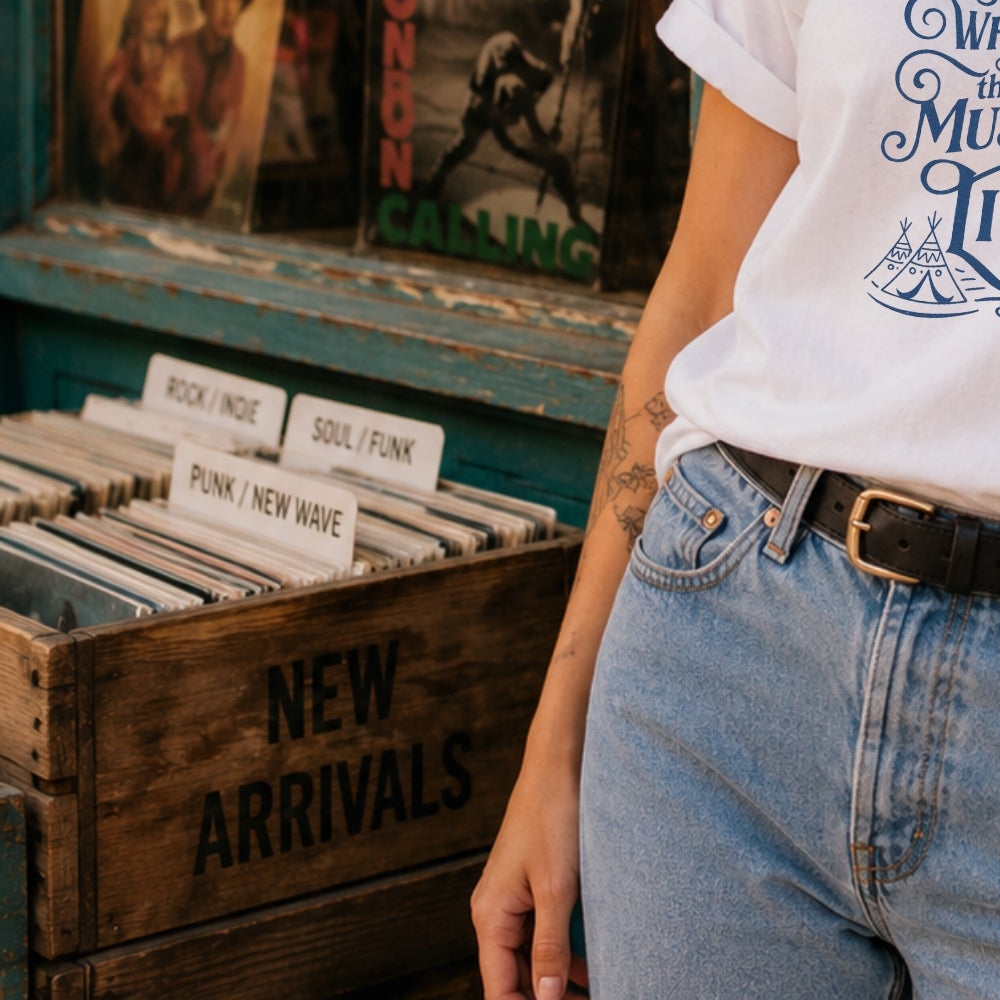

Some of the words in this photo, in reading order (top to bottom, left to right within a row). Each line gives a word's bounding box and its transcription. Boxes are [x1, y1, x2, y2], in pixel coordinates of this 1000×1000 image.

[378, 193, 597, 278] CALLING
[165, 376, 205, 408] ROCK
[222, 392, 260, 425] INDIE
[312, 416, 352, 450] SOUL
[367, 430, 416, 465] FUNK
[189, 463, 236, 502] PUNK
[252, 484, 292, 521] NEW
[294, 496, 344, 539] WAVE
[268, 640, 399, 744] NEW
[193, 732, 472, 876] ARRIVALS
